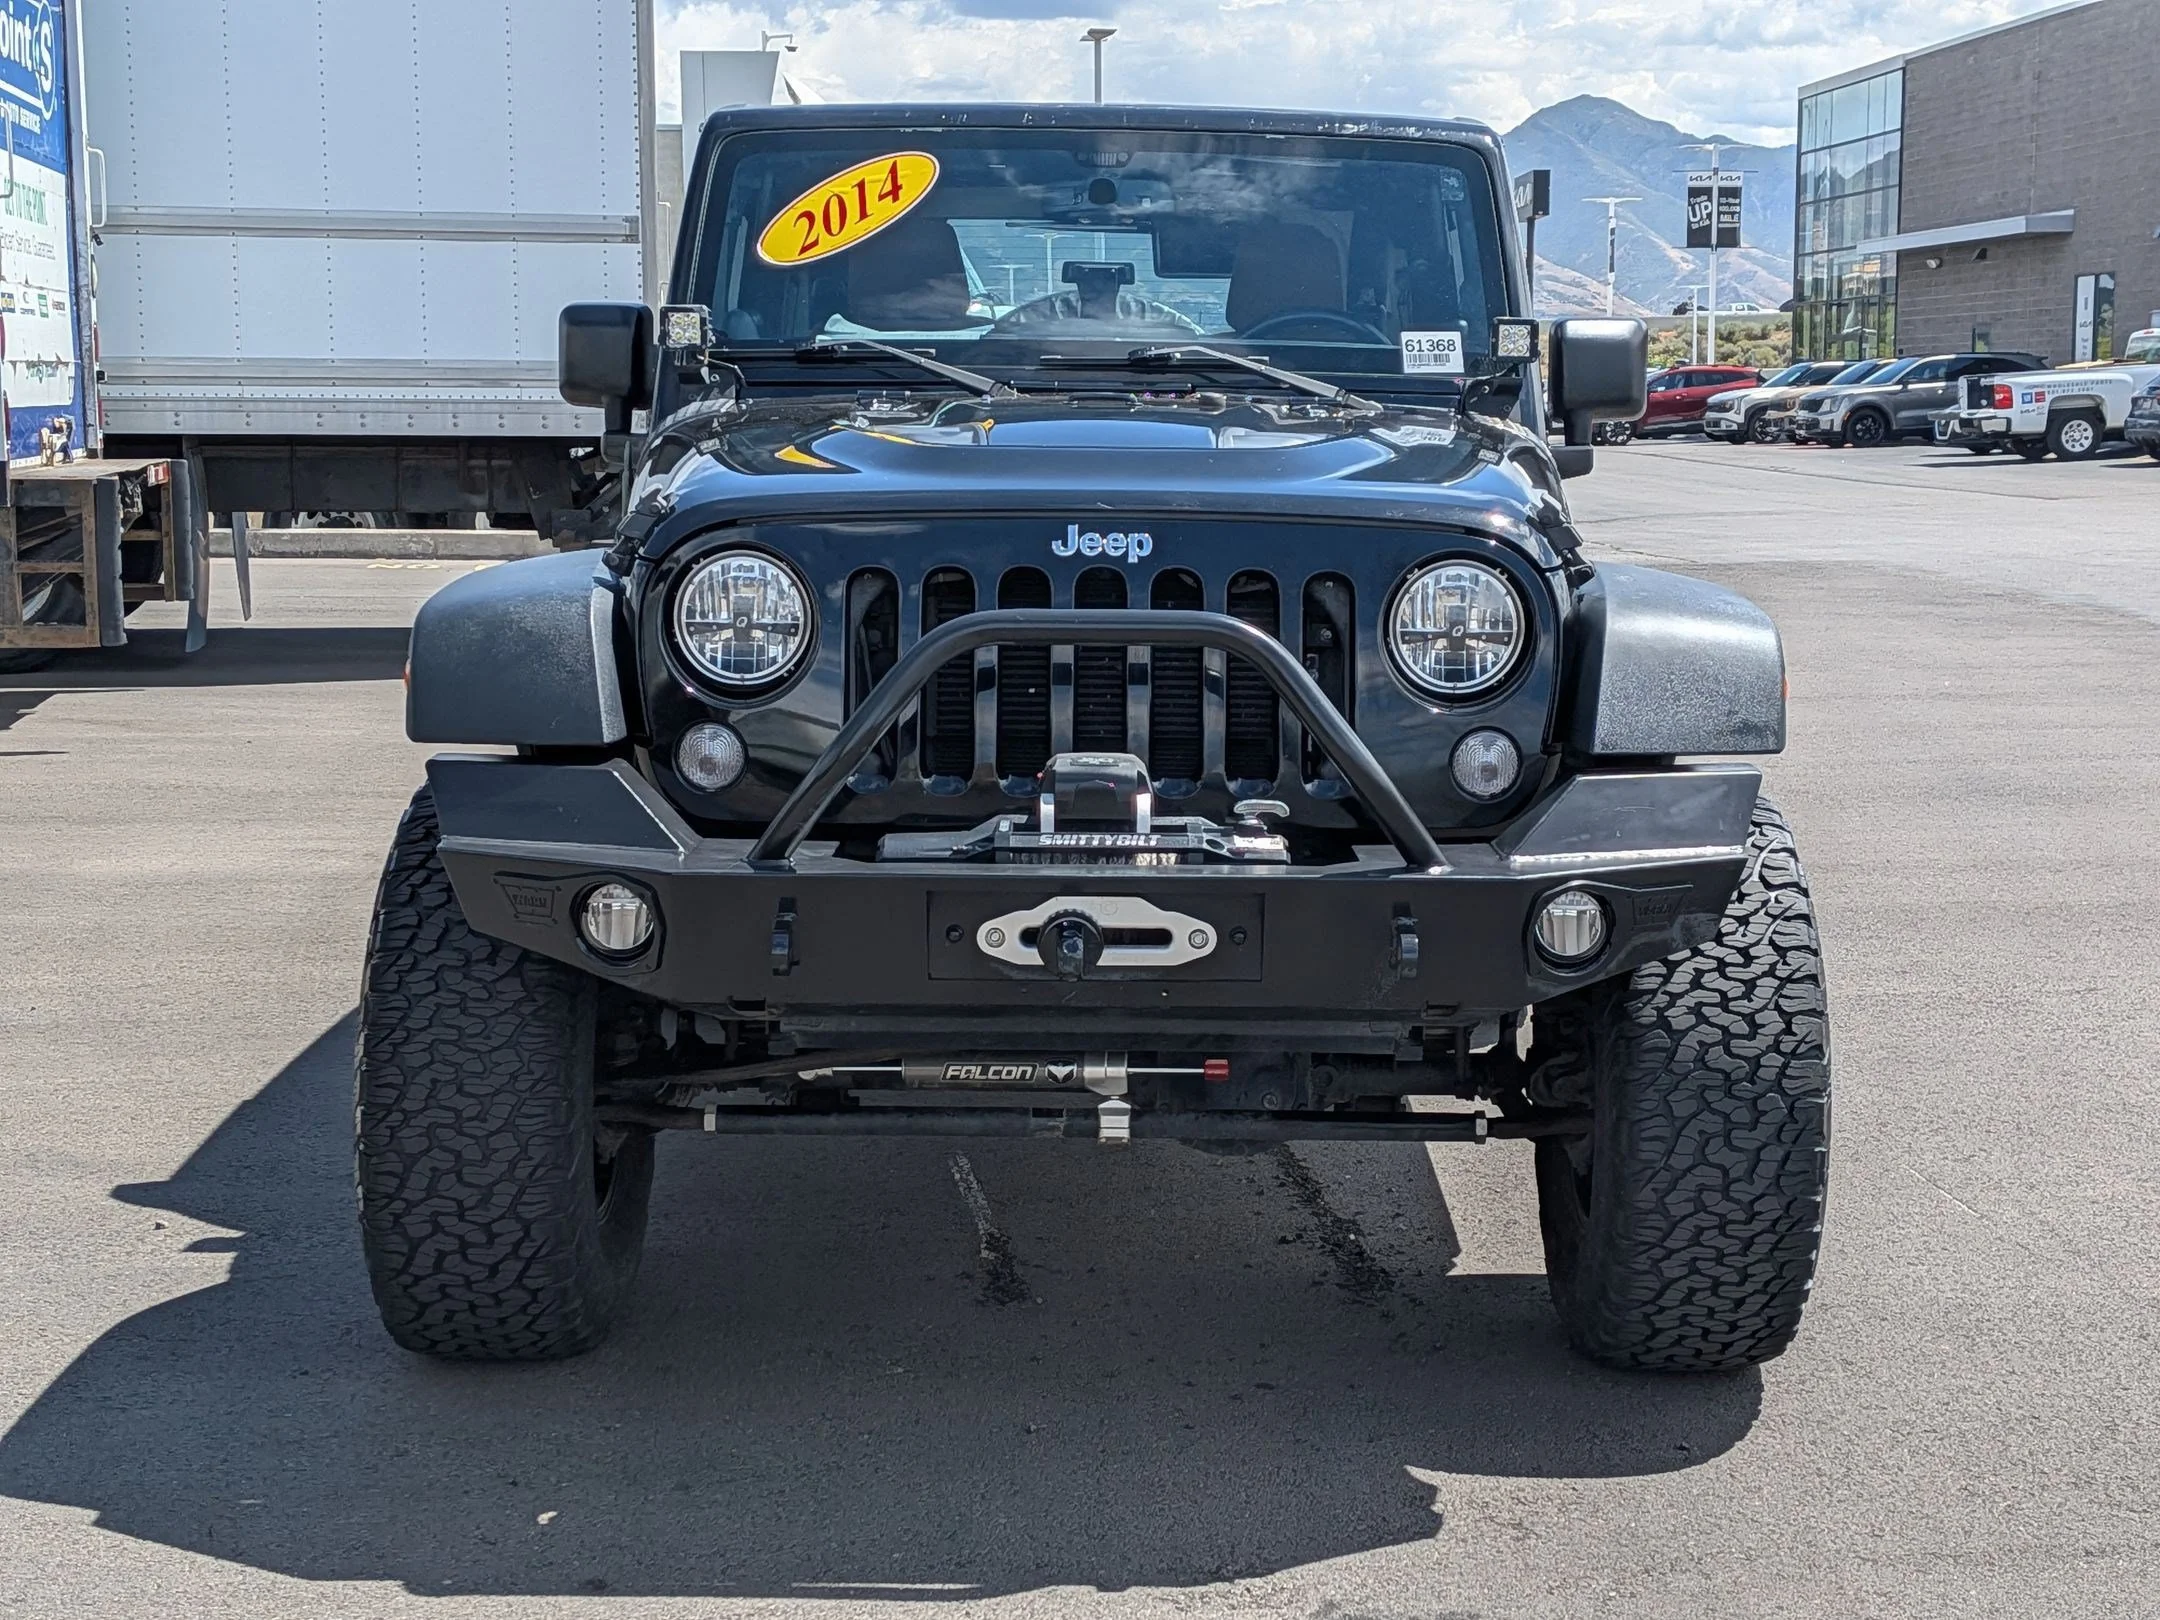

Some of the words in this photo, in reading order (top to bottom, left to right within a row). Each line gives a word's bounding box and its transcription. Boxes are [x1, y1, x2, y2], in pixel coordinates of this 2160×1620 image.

[793, 159, 904, 257] 2014
[1688, 201, 1712, 223] UP
[1404, 338, 1457, 353] 61368
[1051, 523, 1153, 563] Jeep
[1038, 833, 1162, 847] SMITTYBILT
[945, 1065, 1034, 1080] FALCON
